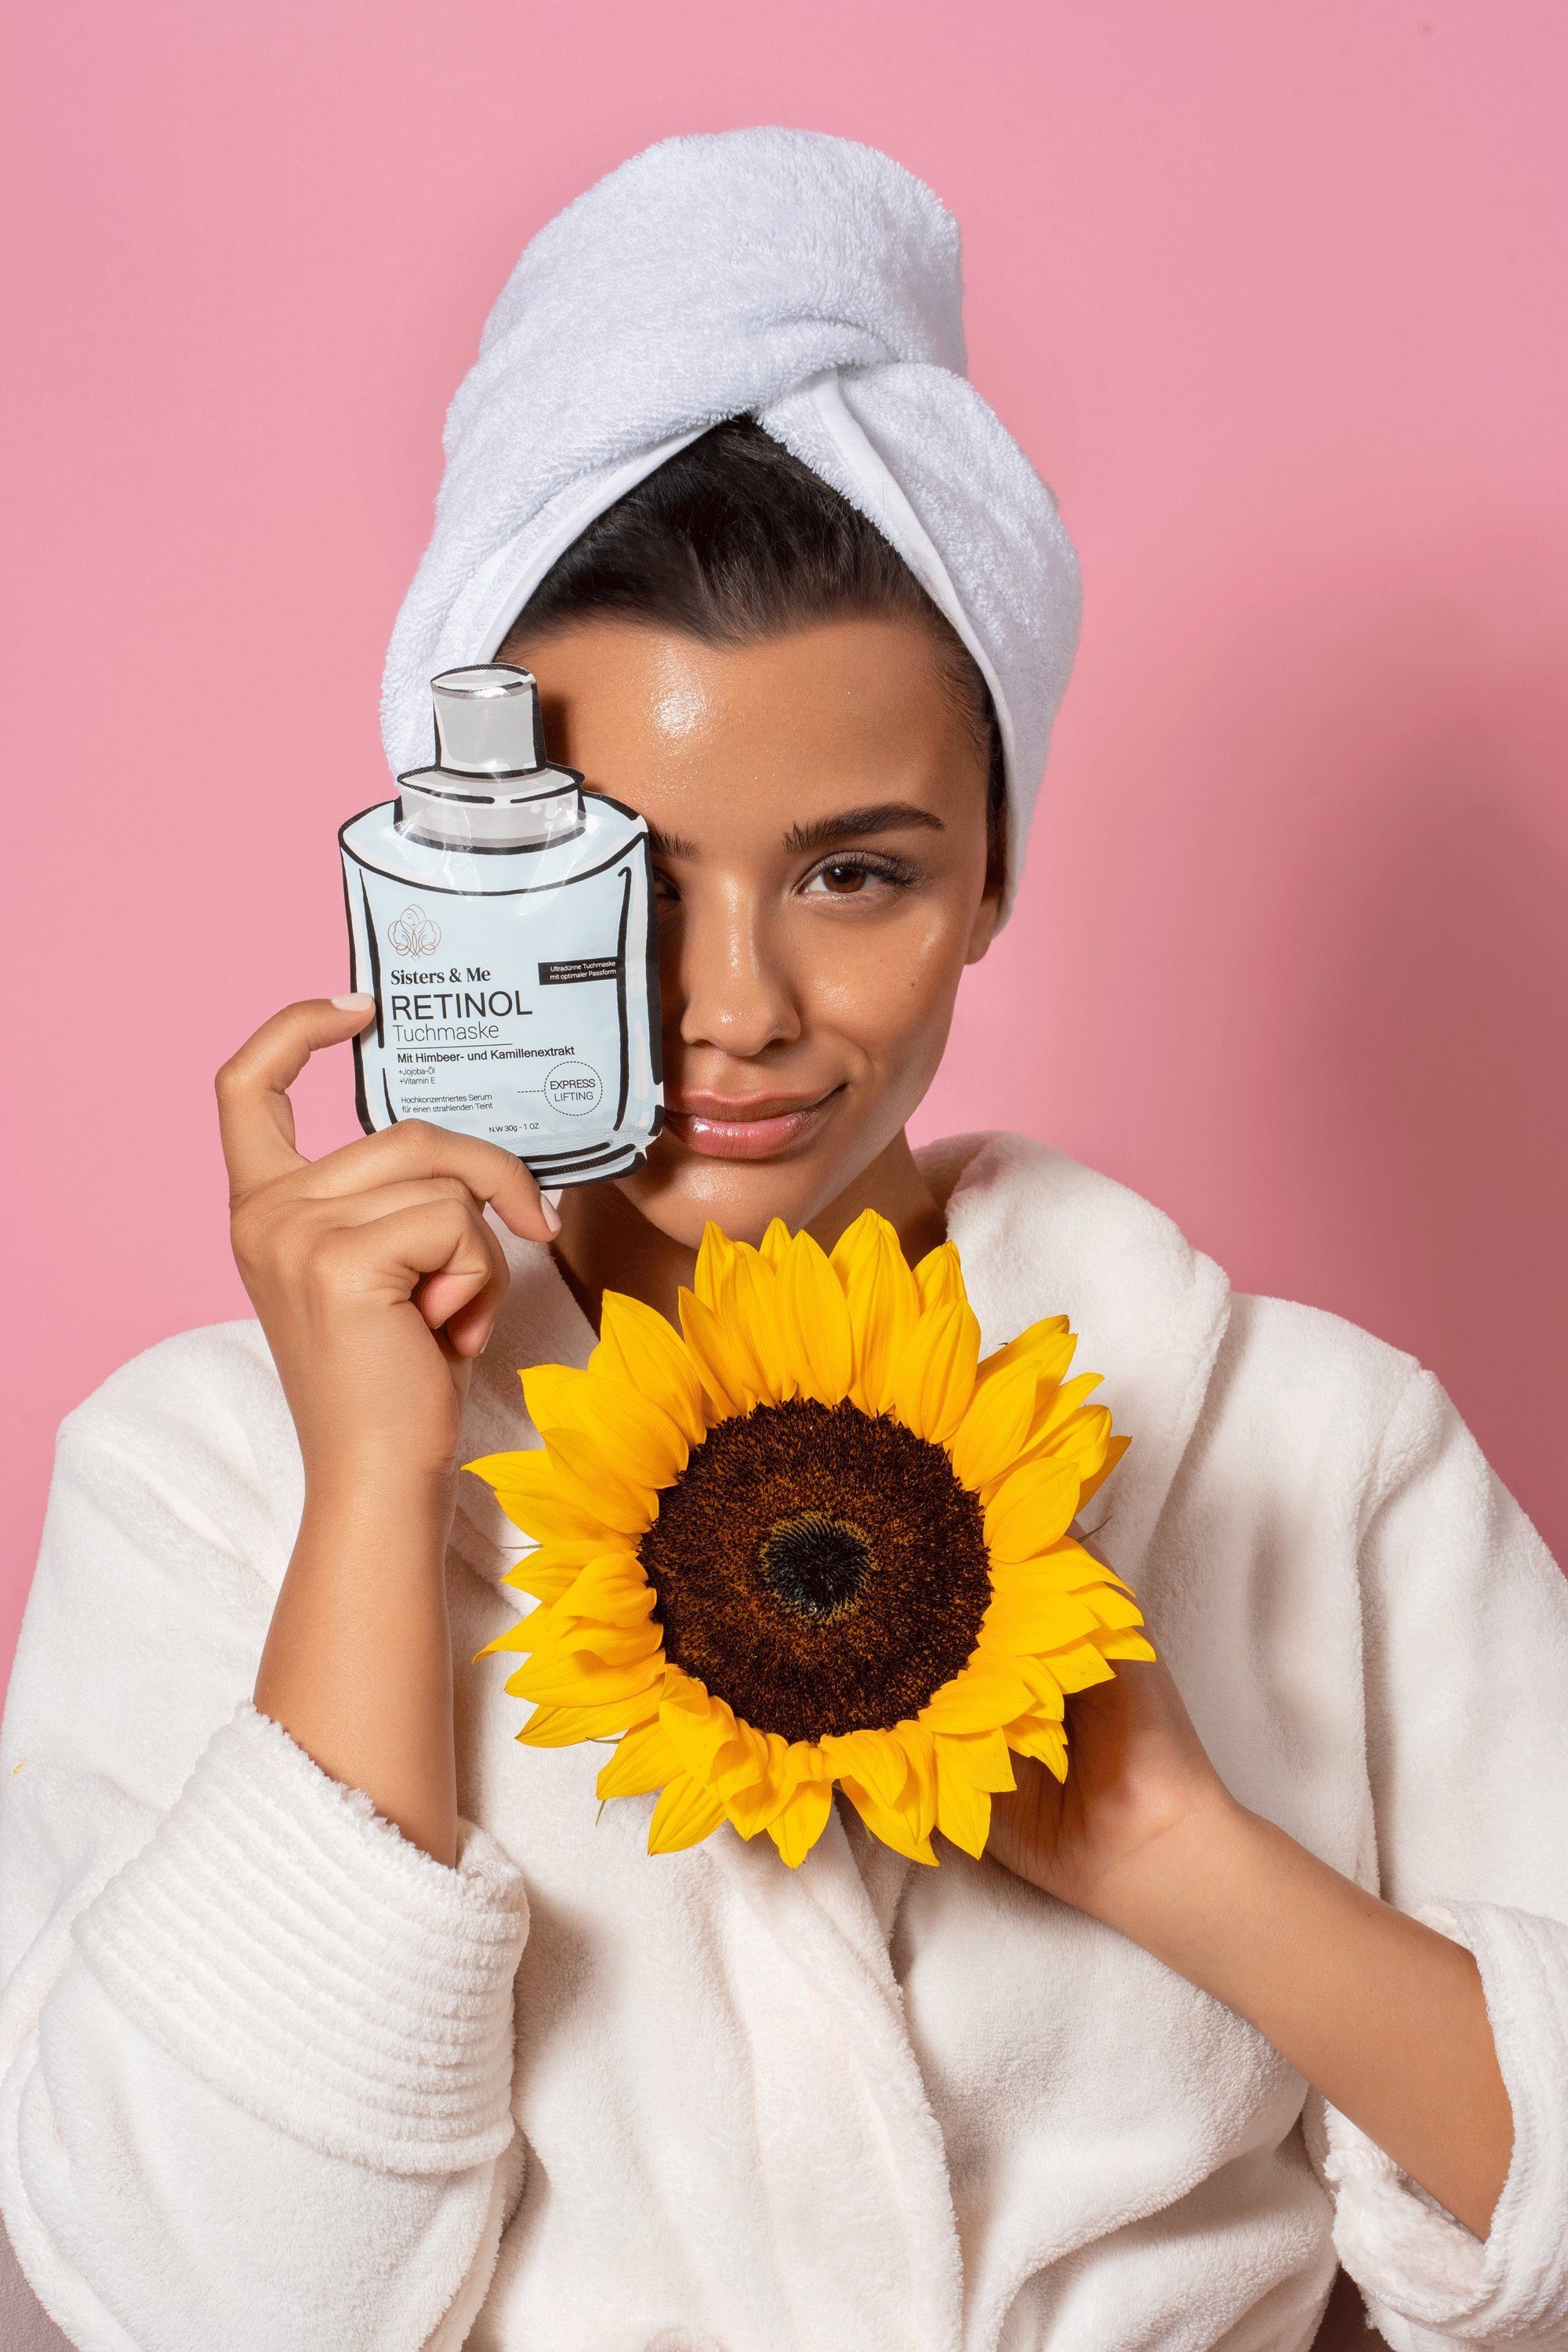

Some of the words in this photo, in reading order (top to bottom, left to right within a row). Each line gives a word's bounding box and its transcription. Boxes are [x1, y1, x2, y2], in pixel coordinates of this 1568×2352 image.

[391, 970, 445, 985] Sisters
[449, 967, 463, 983] &
[466, 967, 491, 982] Me
[561, 971, 588, 980] optimaler
[391, 990, 533, 1020] RETINOL
[393, 1022, 499, 1042] Tuchmaske
[397, 1053, 413, 1063] Mit
[416, 1053, 464, 1063] Himbeer-
[467, 1051, 487, 1061] und
[491, 1046, 575, 1059] Kamillenextrakt
[398, 1066, 435, 1076] +Jojoba-Öl
[550, 1079, 596, 1090] EXPRESS
[401, 1094, 467, 1104] Hochkonzentriertes
[554, 1091, 593, 1102] LIFTING
[433, 1104, 474, 1112] strahlenden
